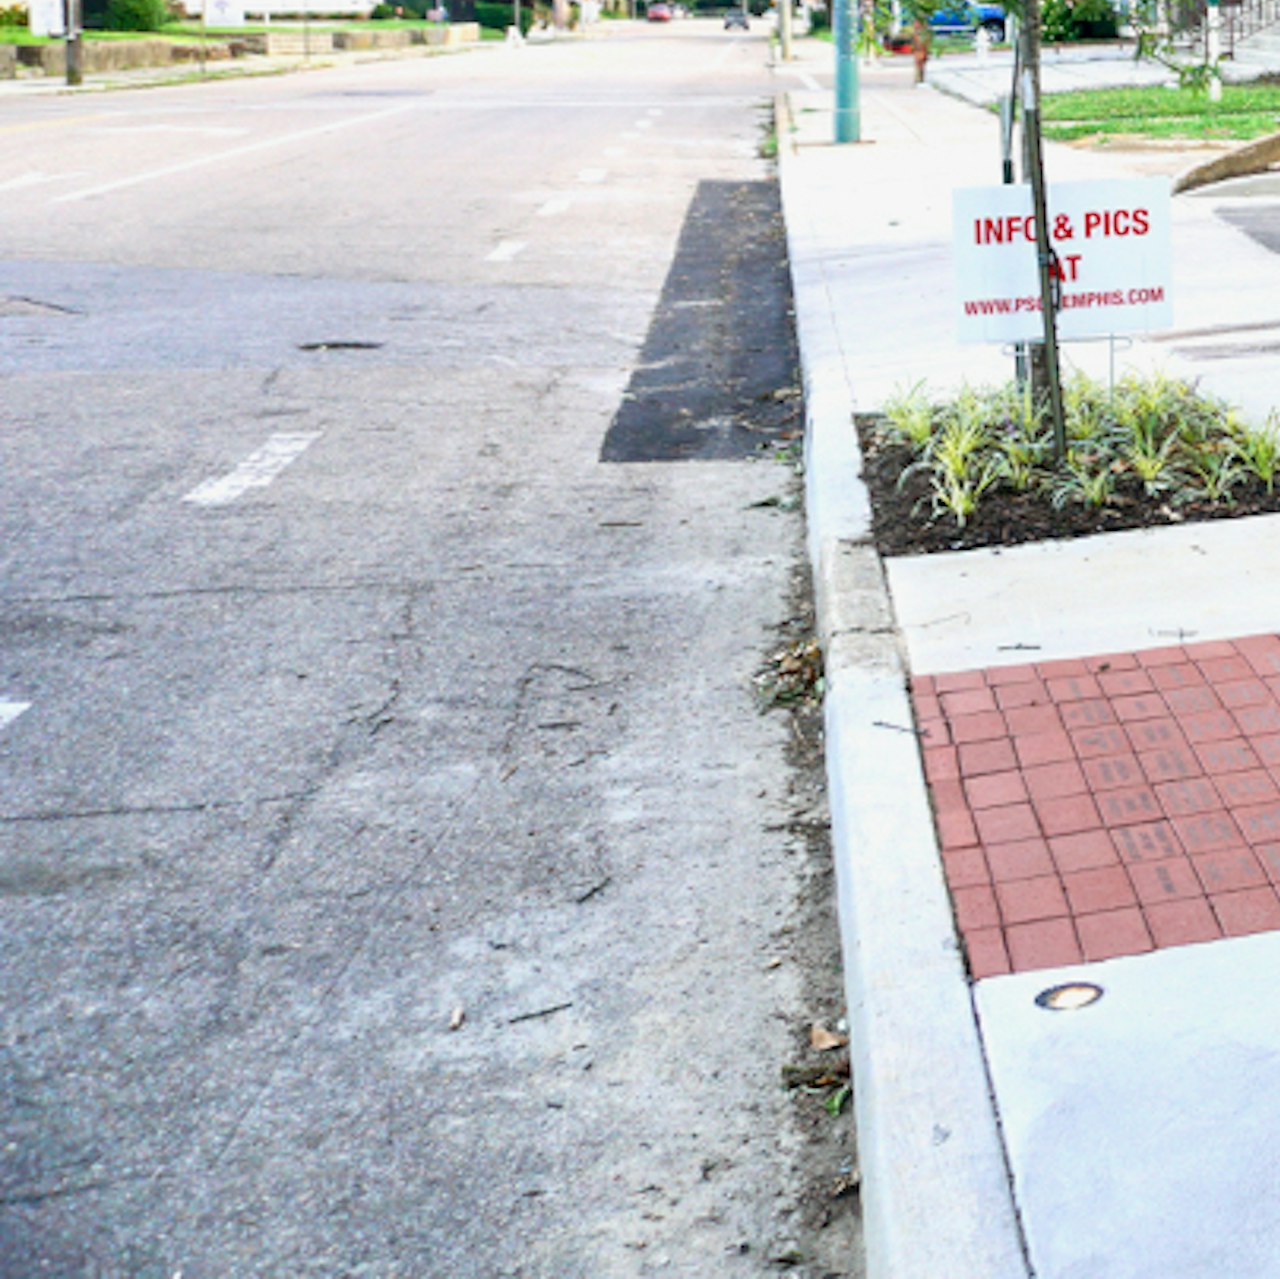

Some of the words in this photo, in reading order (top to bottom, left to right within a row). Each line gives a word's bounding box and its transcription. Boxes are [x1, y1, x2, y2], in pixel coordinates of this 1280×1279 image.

[974, 216, 1038, 245] INFO
[1052, 212, 1074, 242] &
[1084, 208, 1150, 240] PICS
[1048, 254, 1082, 282] AT
